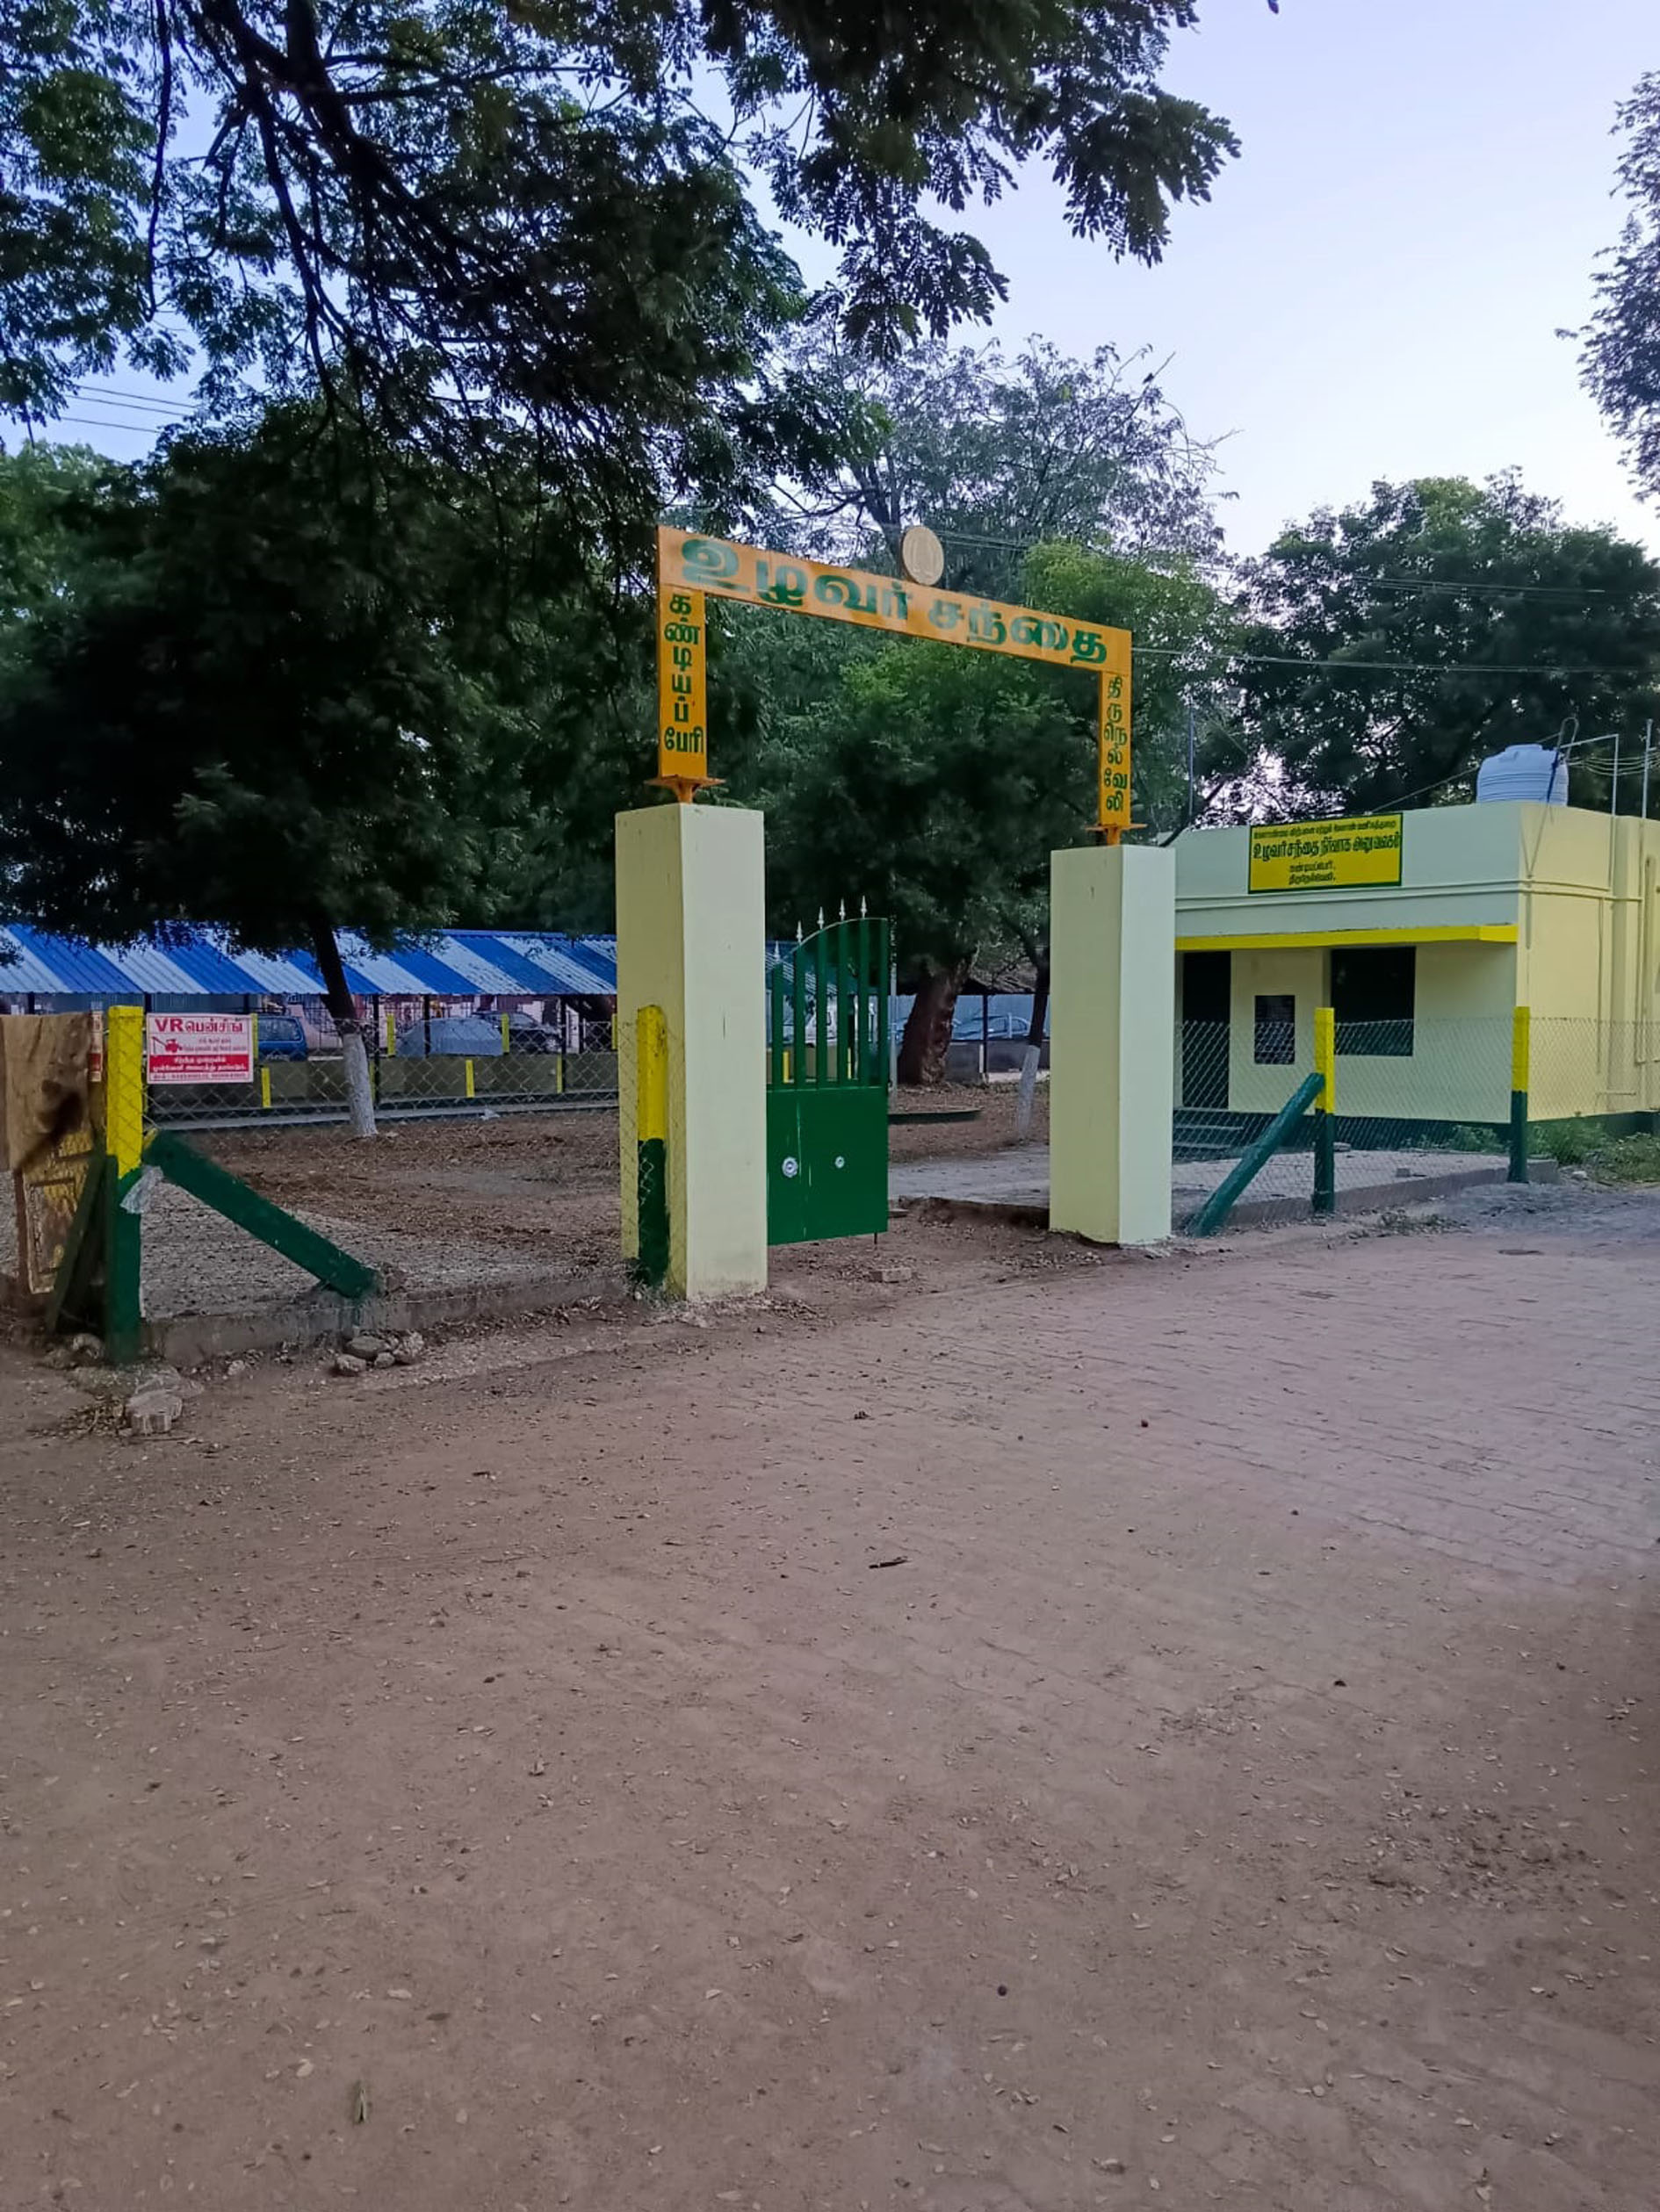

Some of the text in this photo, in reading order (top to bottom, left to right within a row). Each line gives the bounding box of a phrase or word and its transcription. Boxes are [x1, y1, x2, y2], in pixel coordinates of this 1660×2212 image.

[682, 537, 1108, 665] உழவர் சந்தை
[155, 1018, 184, 1033] VR
